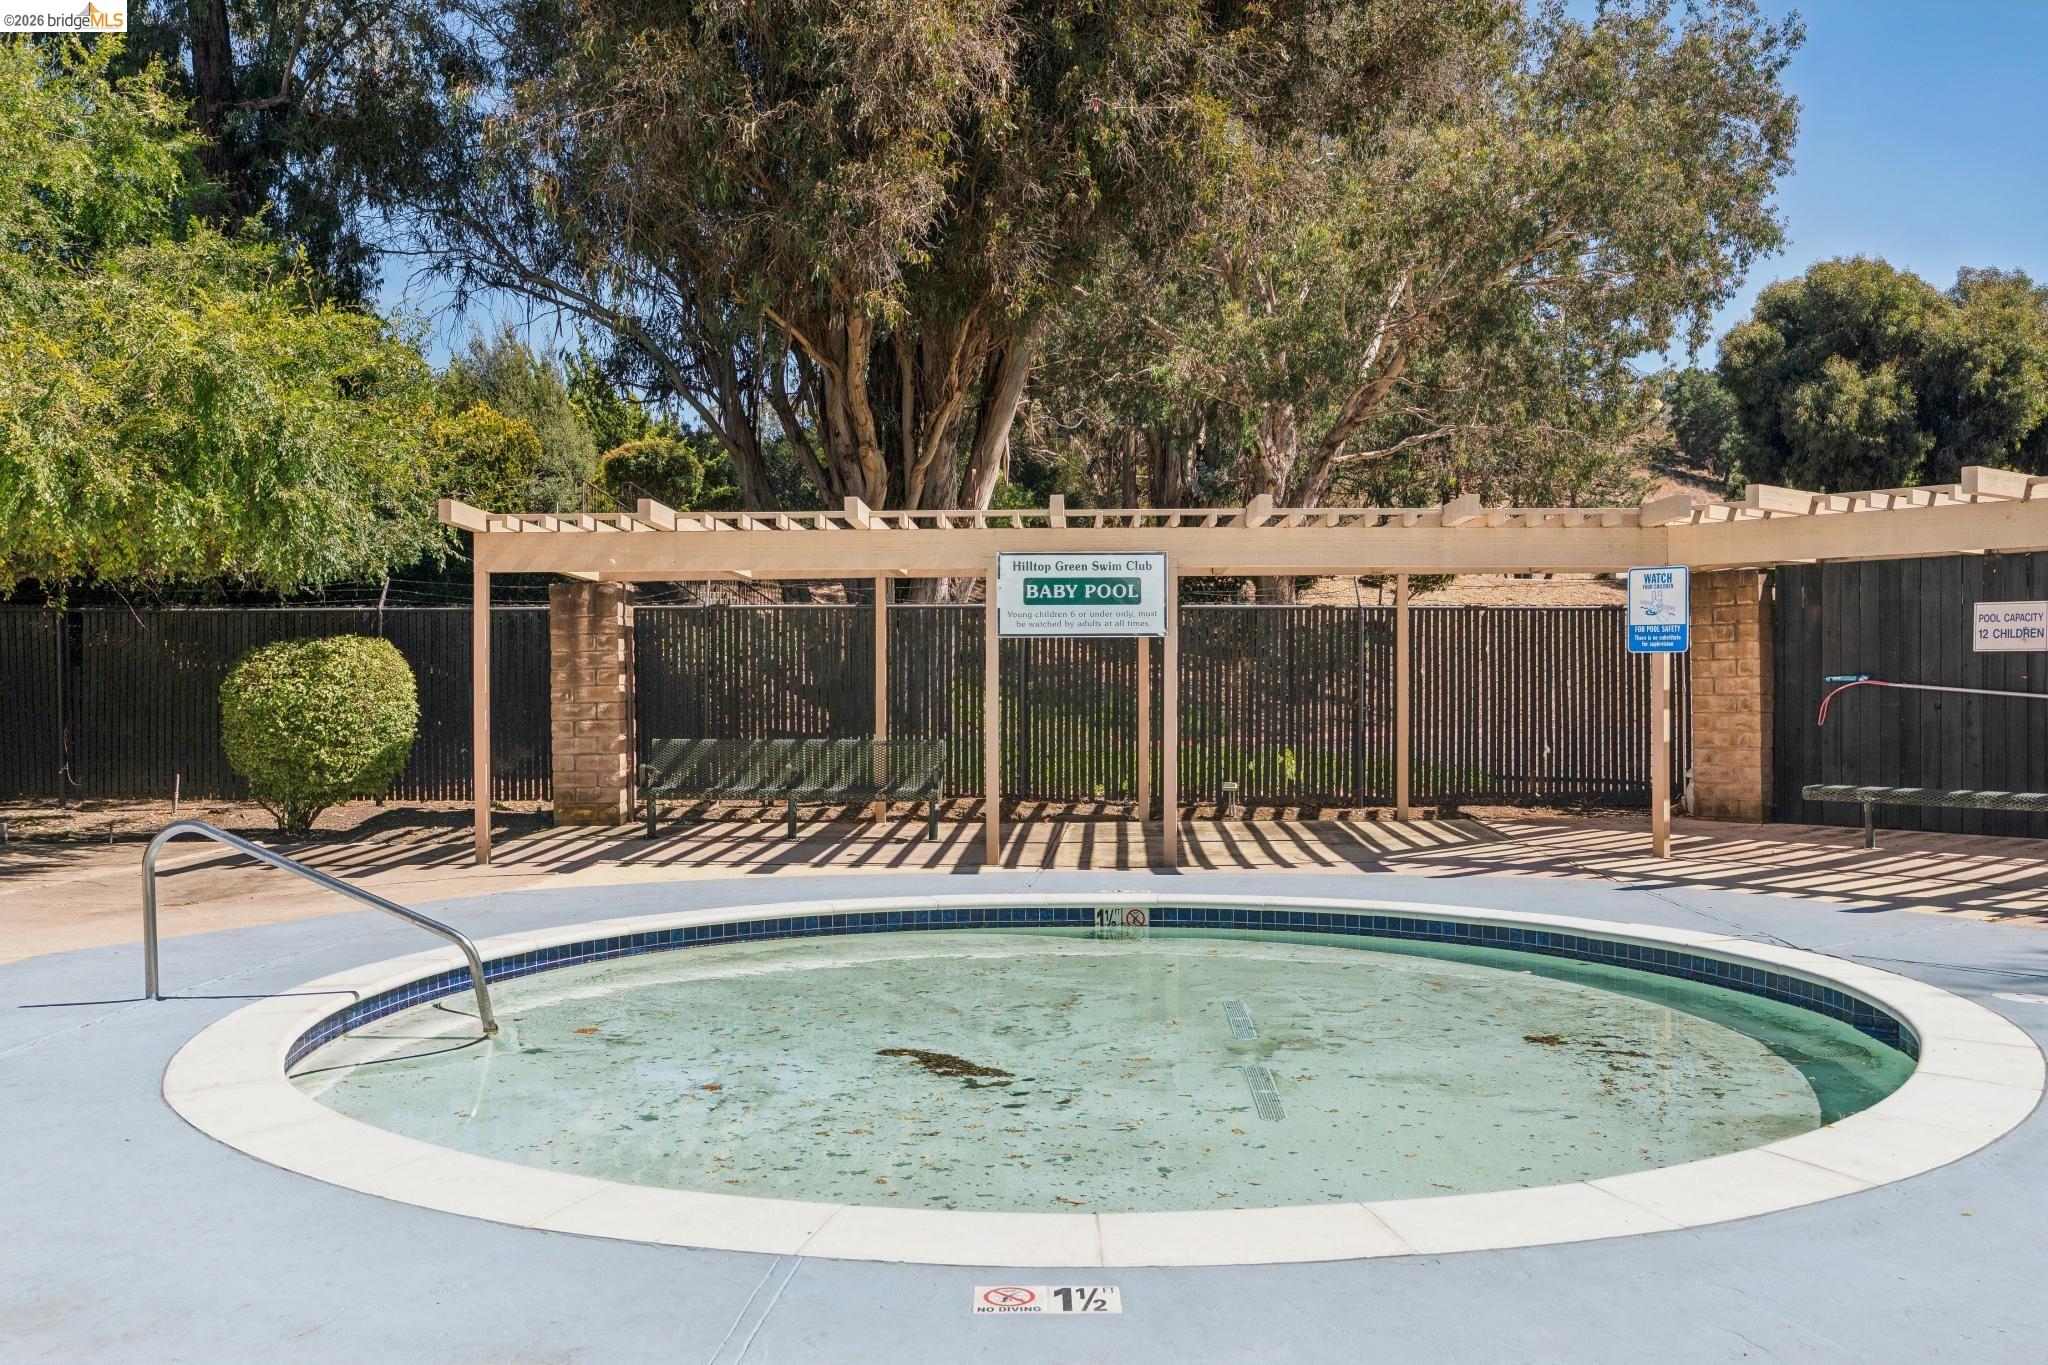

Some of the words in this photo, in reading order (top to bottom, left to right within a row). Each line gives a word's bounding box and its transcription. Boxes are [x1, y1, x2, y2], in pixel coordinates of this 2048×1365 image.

[1013, 561, 1051, 573] Hilltop
[1056, 561, 1088, 571] Green
[1092, 561, 1122, 571] Swim
[1126, 561, 1152, 571] Club
[1644, 573, 1672, 583] WATCH
[1026, 584, 1078, 598] BABY
[1085, 584, 1138, 598] POOL
[1008, 611, 1032, 619] Young
[1979, 614, 2000, 622] POOL
[2004, 613, 2043, 622] CAPACITY
[1978, 629, 1988, 638] 12
[1993, 628, 2044, 638] CHILDREN
